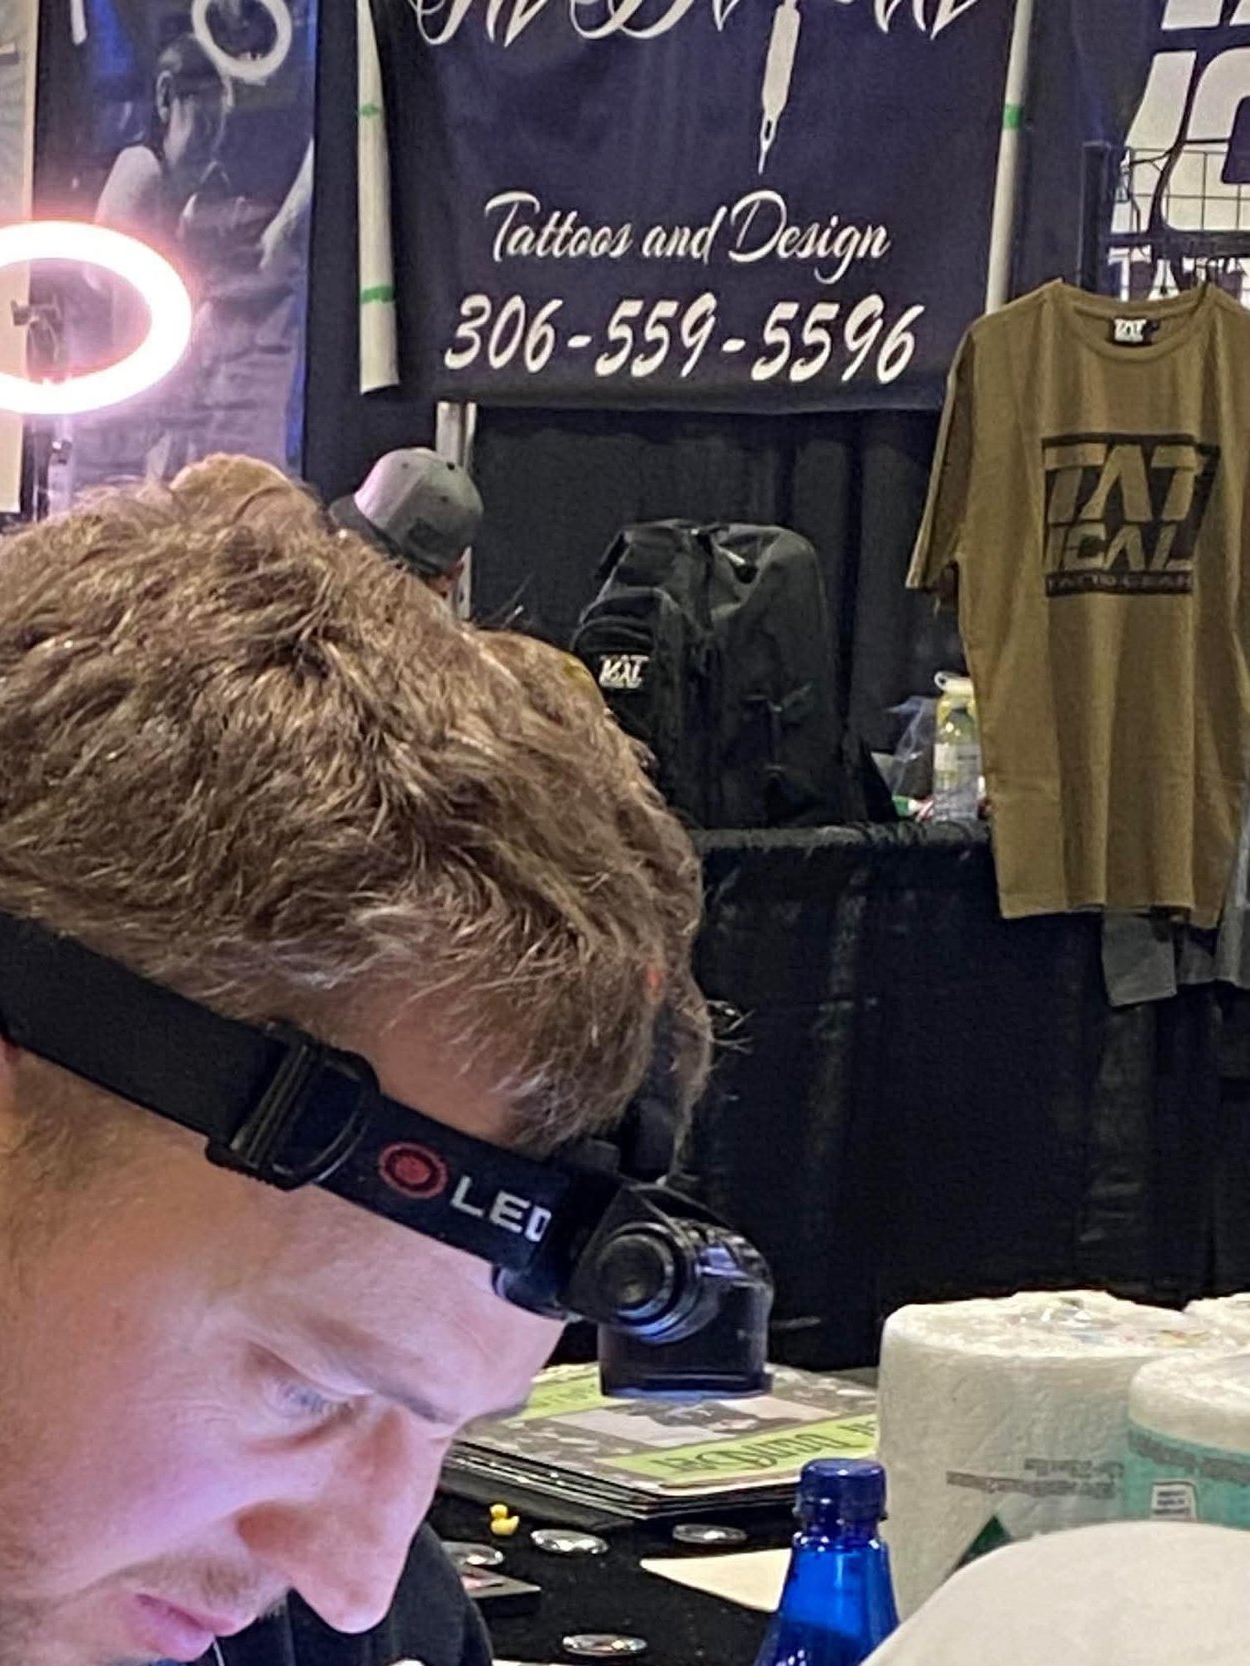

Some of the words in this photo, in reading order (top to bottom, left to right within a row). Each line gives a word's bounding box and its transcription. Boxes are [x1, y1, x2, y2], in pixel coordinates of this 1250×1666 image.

[485, 191, 634, 262] Tattoos
[641, 205, 727, 264] and
[728, 190, 892, 284] Design
[444, 292, 925, 385] 306-559-5596
[1044, 440, 1198, 522] TAT
[450, 1174, 552, 1242] LED
